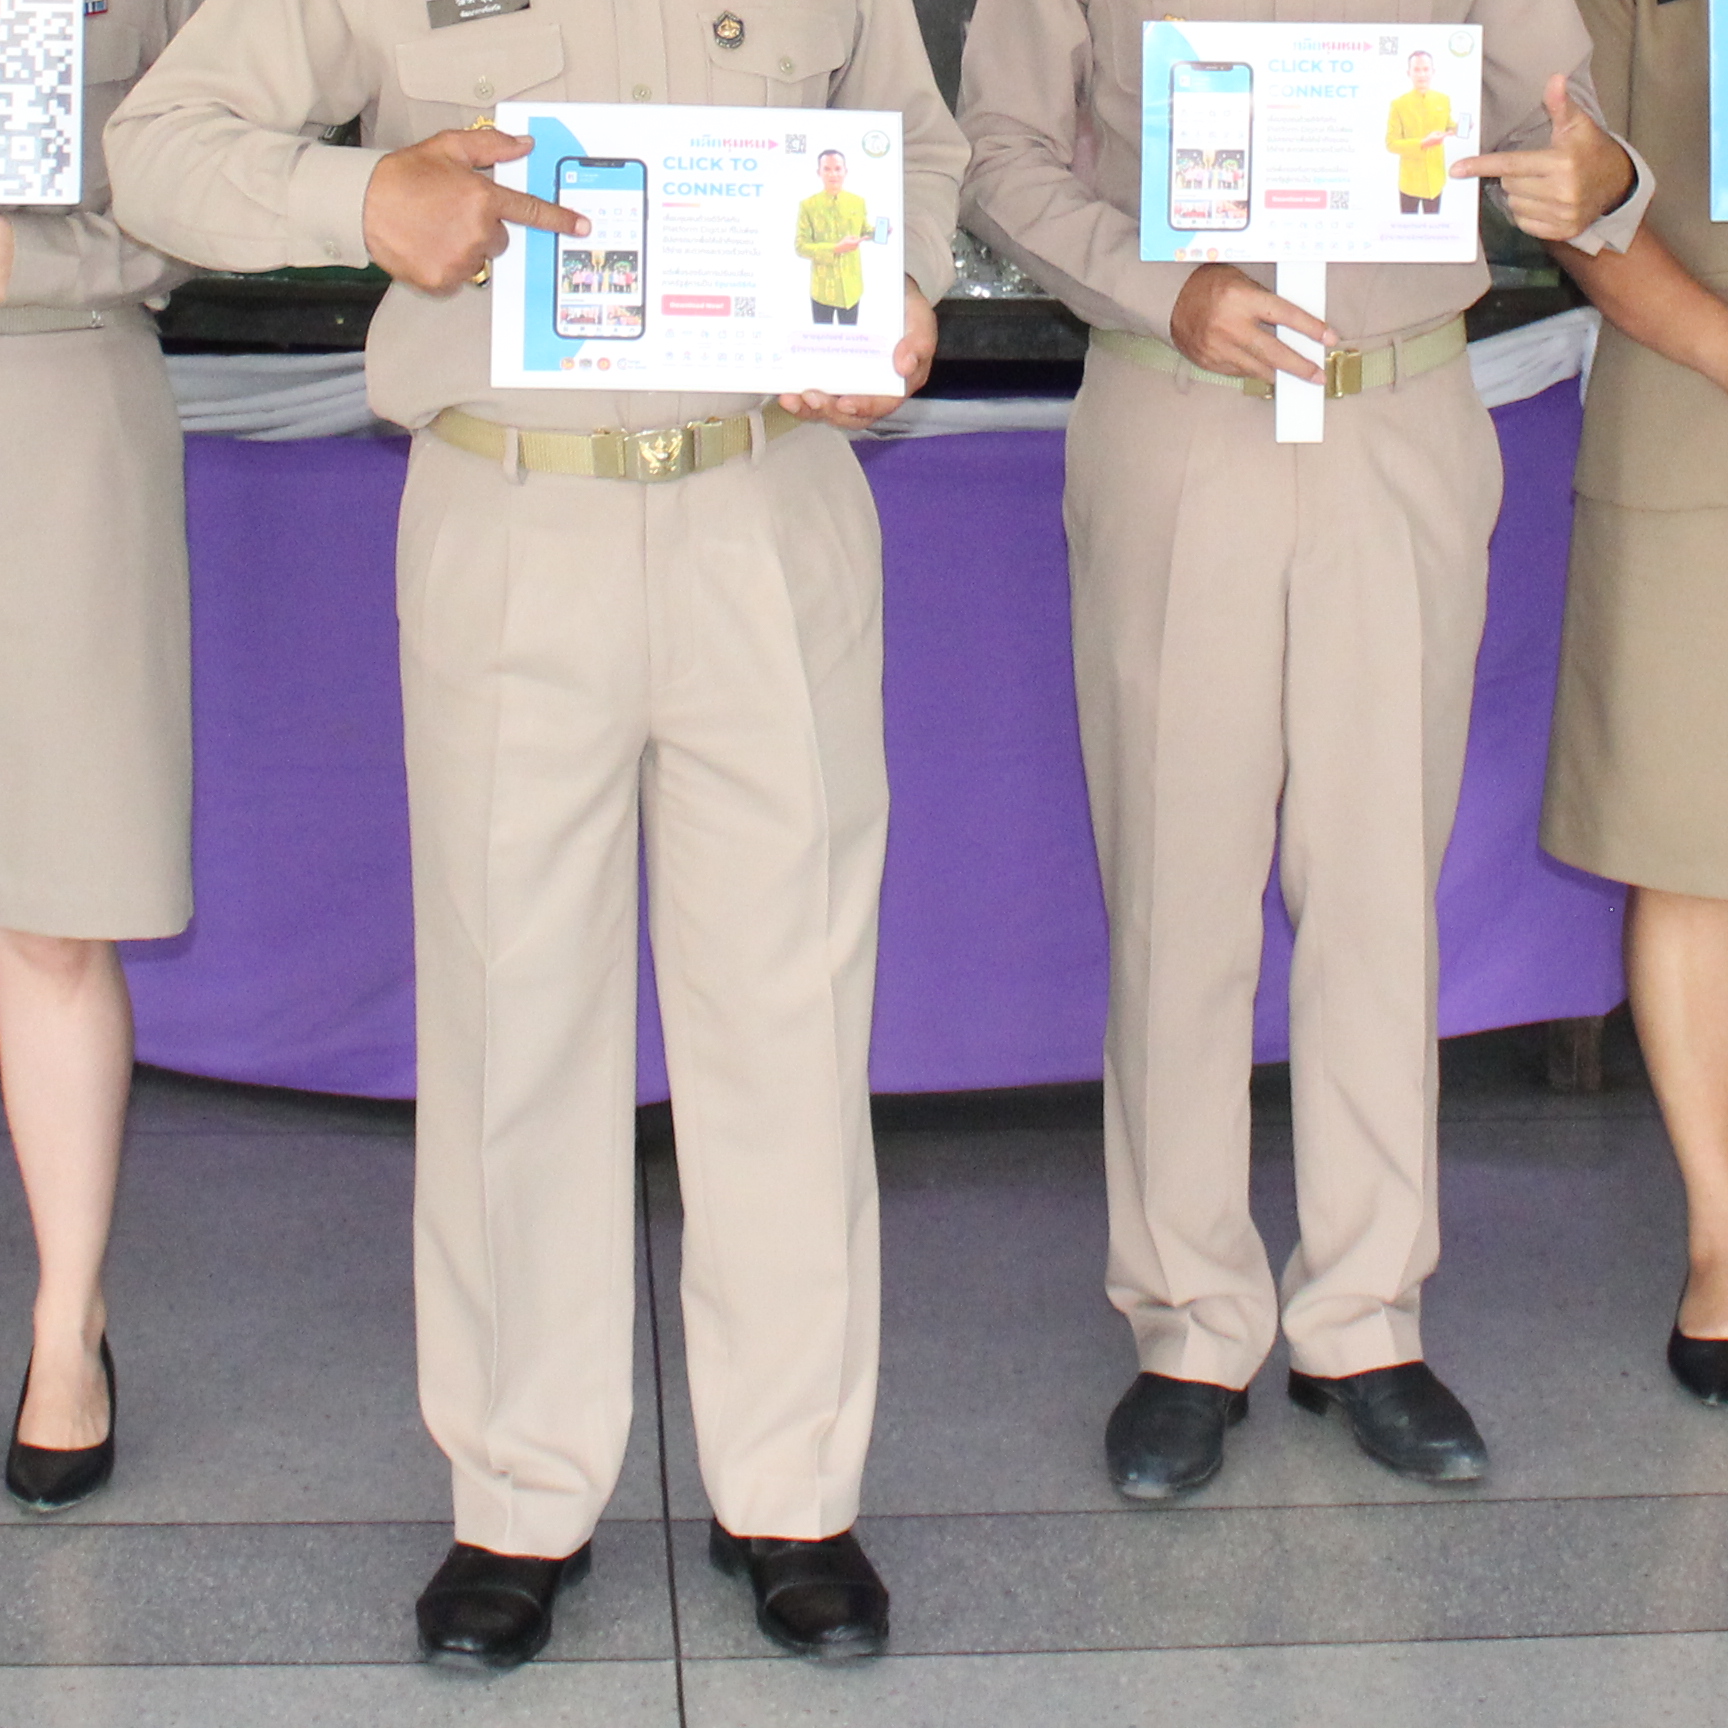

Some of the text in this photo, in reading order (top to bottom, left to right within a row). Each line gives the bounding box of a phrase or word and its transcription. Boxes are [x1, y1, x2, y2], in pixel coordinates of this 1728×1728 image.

[1268, 59, 1354, 73] CLICK TO
[1269, 84, 1359, 98] CONNECT
[663, 156, 758, 172] CLICK TO
[663, 182, 764, 197] CONNECT
